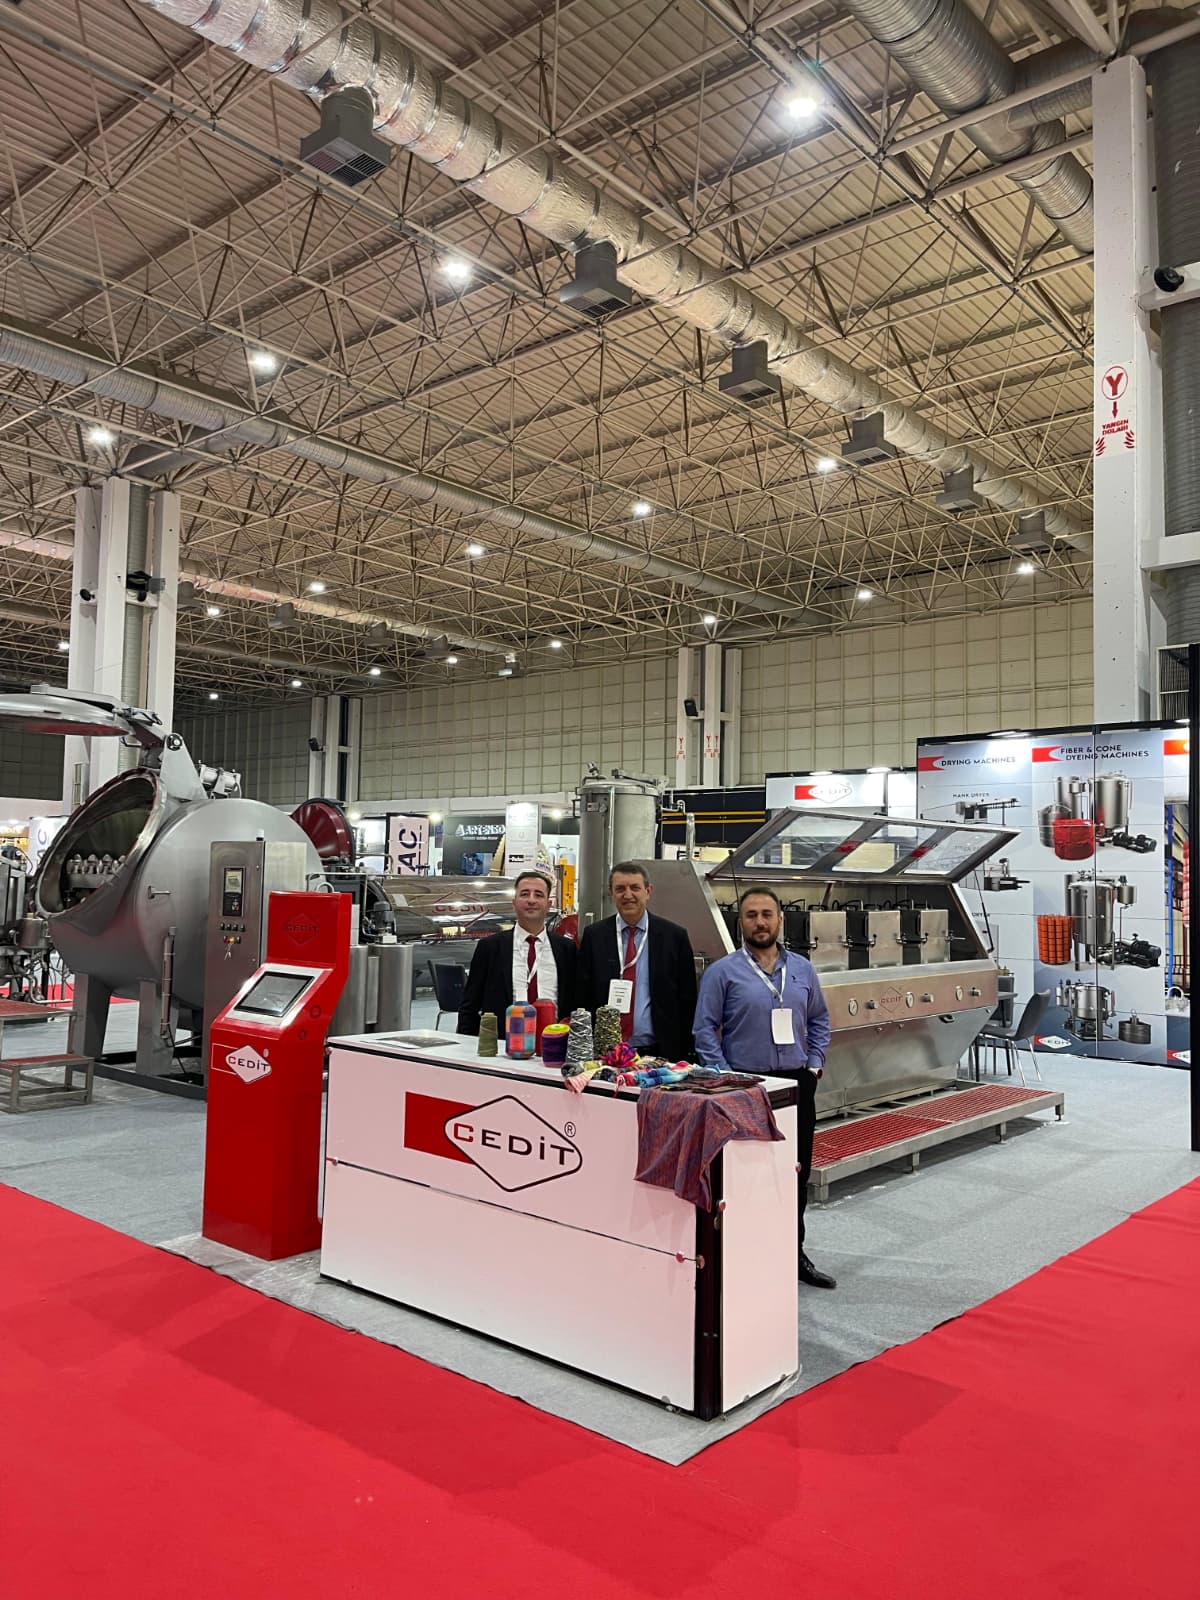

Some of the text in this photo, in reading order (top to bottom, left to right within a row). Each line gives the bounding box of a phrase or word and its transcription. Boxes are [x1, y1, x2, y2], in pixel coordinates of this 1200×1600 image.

[1106, 372, 1123, 396] Y
[1060, 747, 1084, 755] FIBER
[1095, 744, 1122, 752] CONE
[1065, 750, 1149, 761] DYEING MACHINES
[941, 758, 971, 767] DRYING
